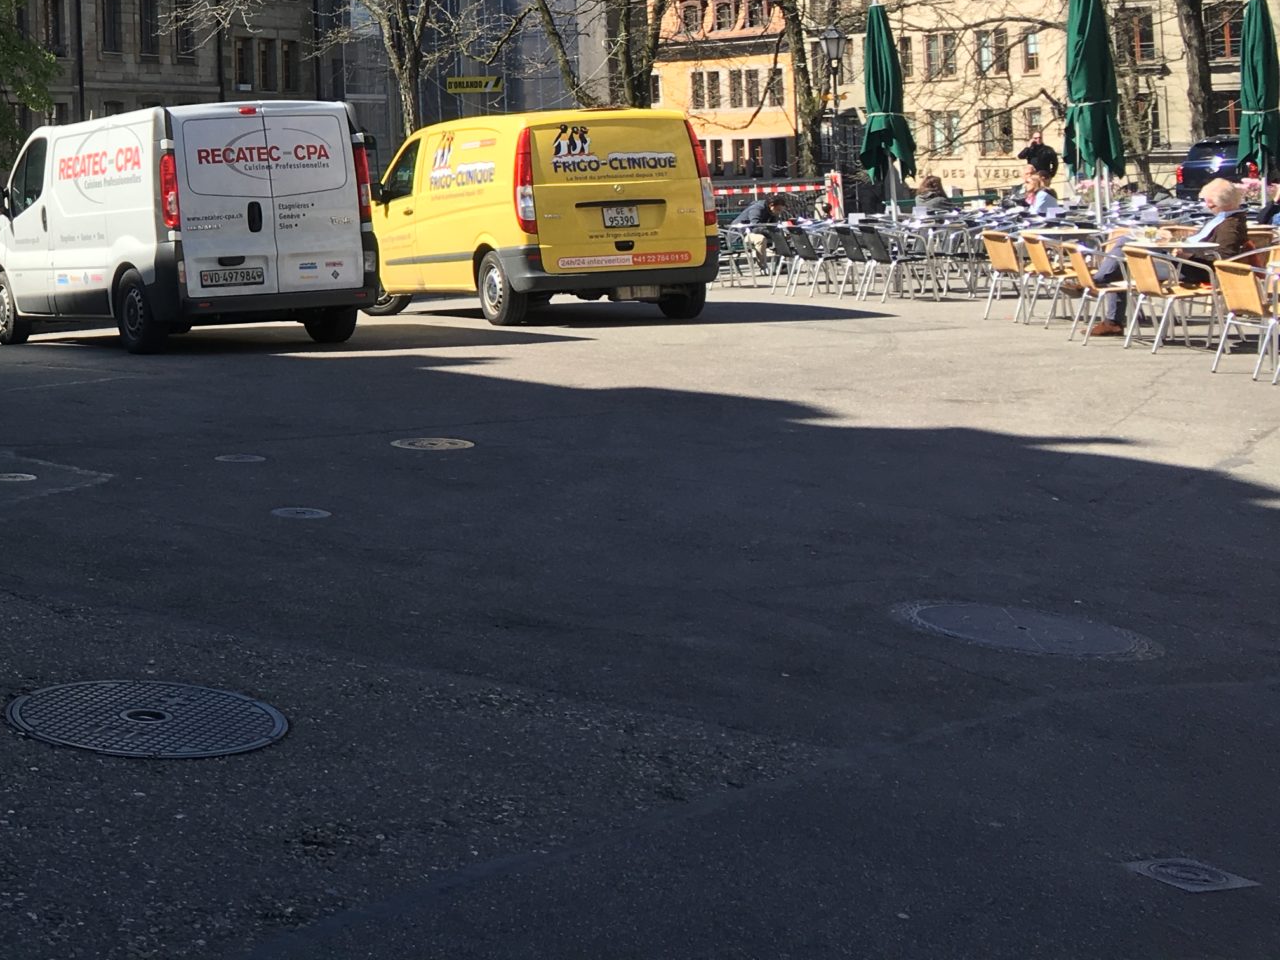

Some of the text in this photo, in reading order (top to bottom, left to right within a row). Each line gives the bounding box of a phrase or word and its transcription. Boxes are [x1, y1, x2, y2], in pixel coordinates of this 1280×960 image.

[243, 161, 330, 172] Cuisines Professionnelles
[553, 156, 677, 173] FRIGO-CLINIQUE
[615, 207, 625, 215] GE
[279, 222, 293, 230] Sion
[608, 215, 635, 226] 95390
[587, 255, 631, 266] intervention
[647, 254, 656, 262] 22
